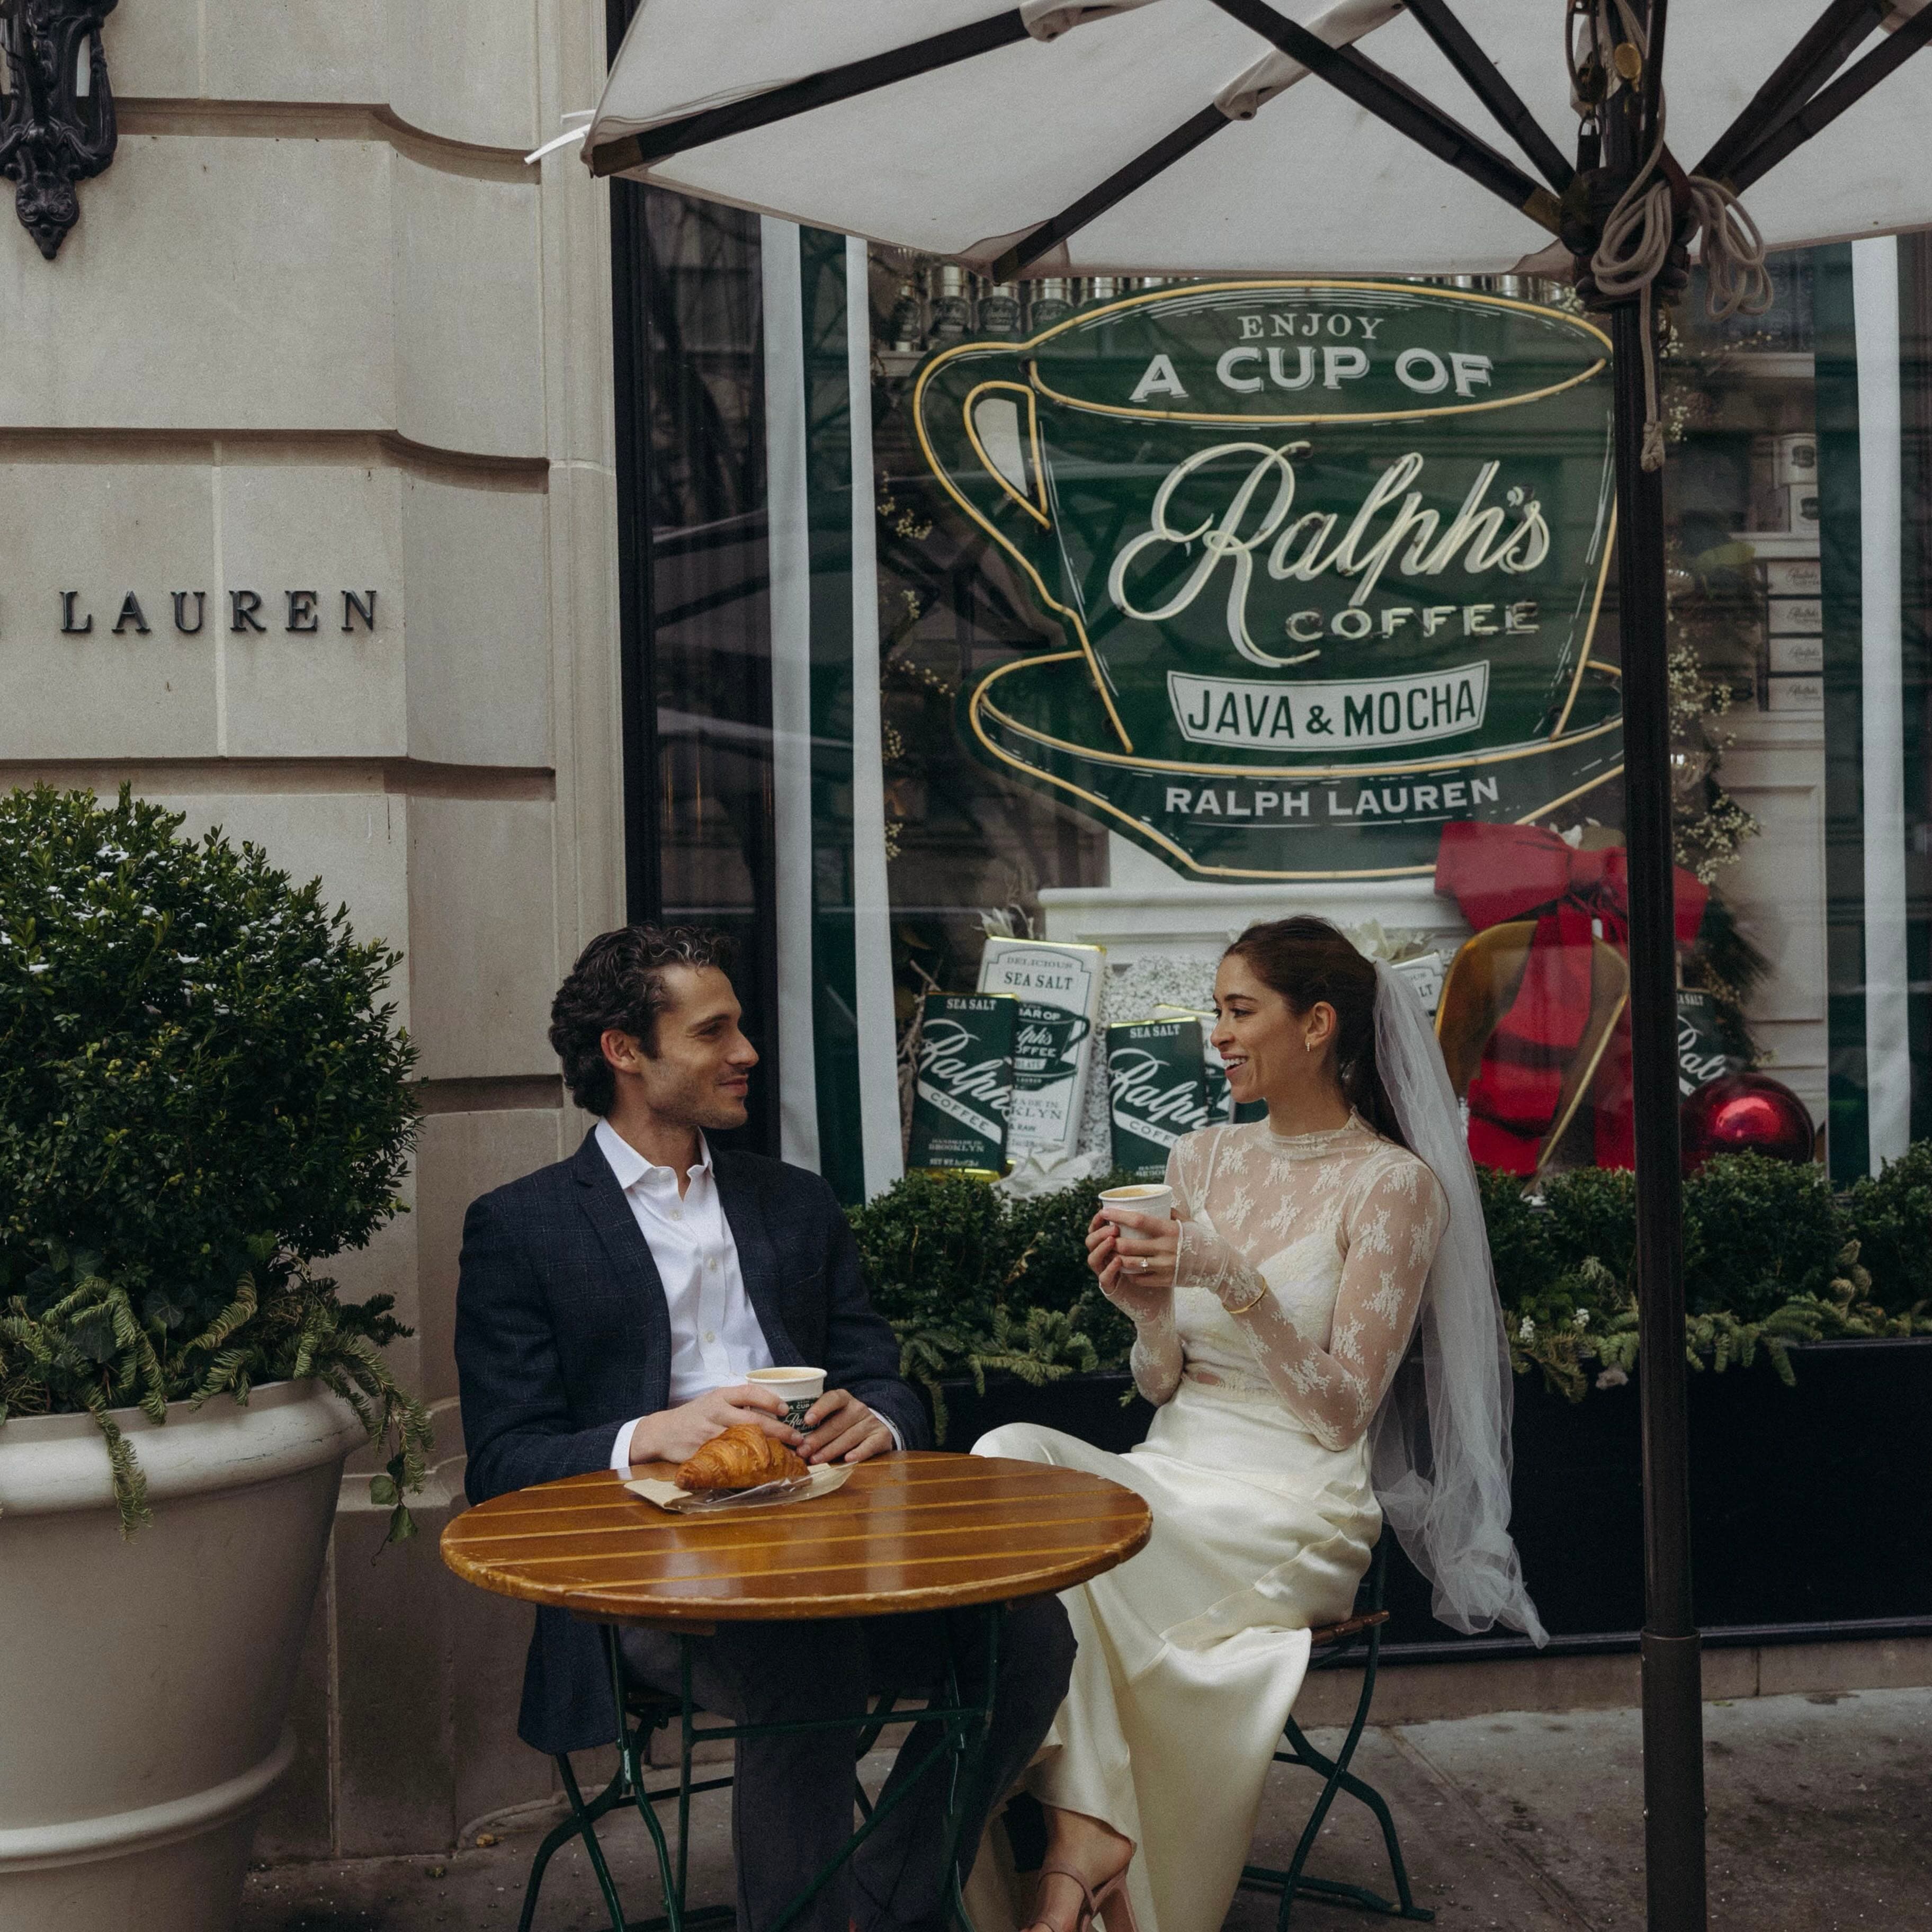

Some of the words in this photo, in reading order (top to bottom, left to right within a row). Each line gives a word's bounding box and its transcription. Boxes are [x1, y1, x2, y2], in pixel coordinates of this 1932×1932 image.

[1237, 314, 1384, 340] ENJOY
[1129, 354, 1189, 402] A
[1215, 346, 1370, 393] CUP
[1394, 347, 1493, 398] OF
[1108, 440, 1550, 668] Ralph's
[59, 590, 377, 633] LAUREN
[1285, 601, 1540, 642] COFFEE
[1187, 690, 1294, 739] JAVA
[1306, 704, 1334, 735] &
[1345, 679, 1476, 737] MOCHA
[1166, 786, 1310, 817] RALPH
[1328, 777, 1499, 817] LAUREN
[1004, 971, 1031, 986] SEA
[1035, 974, 1073, 990] SALT
[1419, 983, 1433, 997] LT
[946, 998, 971, 1009] SEA
[972, 999, 997, 1010] SALT
[1686, 995, 1704, 1006] SALT
[1043, 1011, 1061, 1021] OF
[1130, 1027, 1151, 1039] SEA
[1152, 1024, 1180, 1036] SALT
[931, 1092, 989, 1131] COFFEE
[1130, 1120, 1179, 1144] COFF
